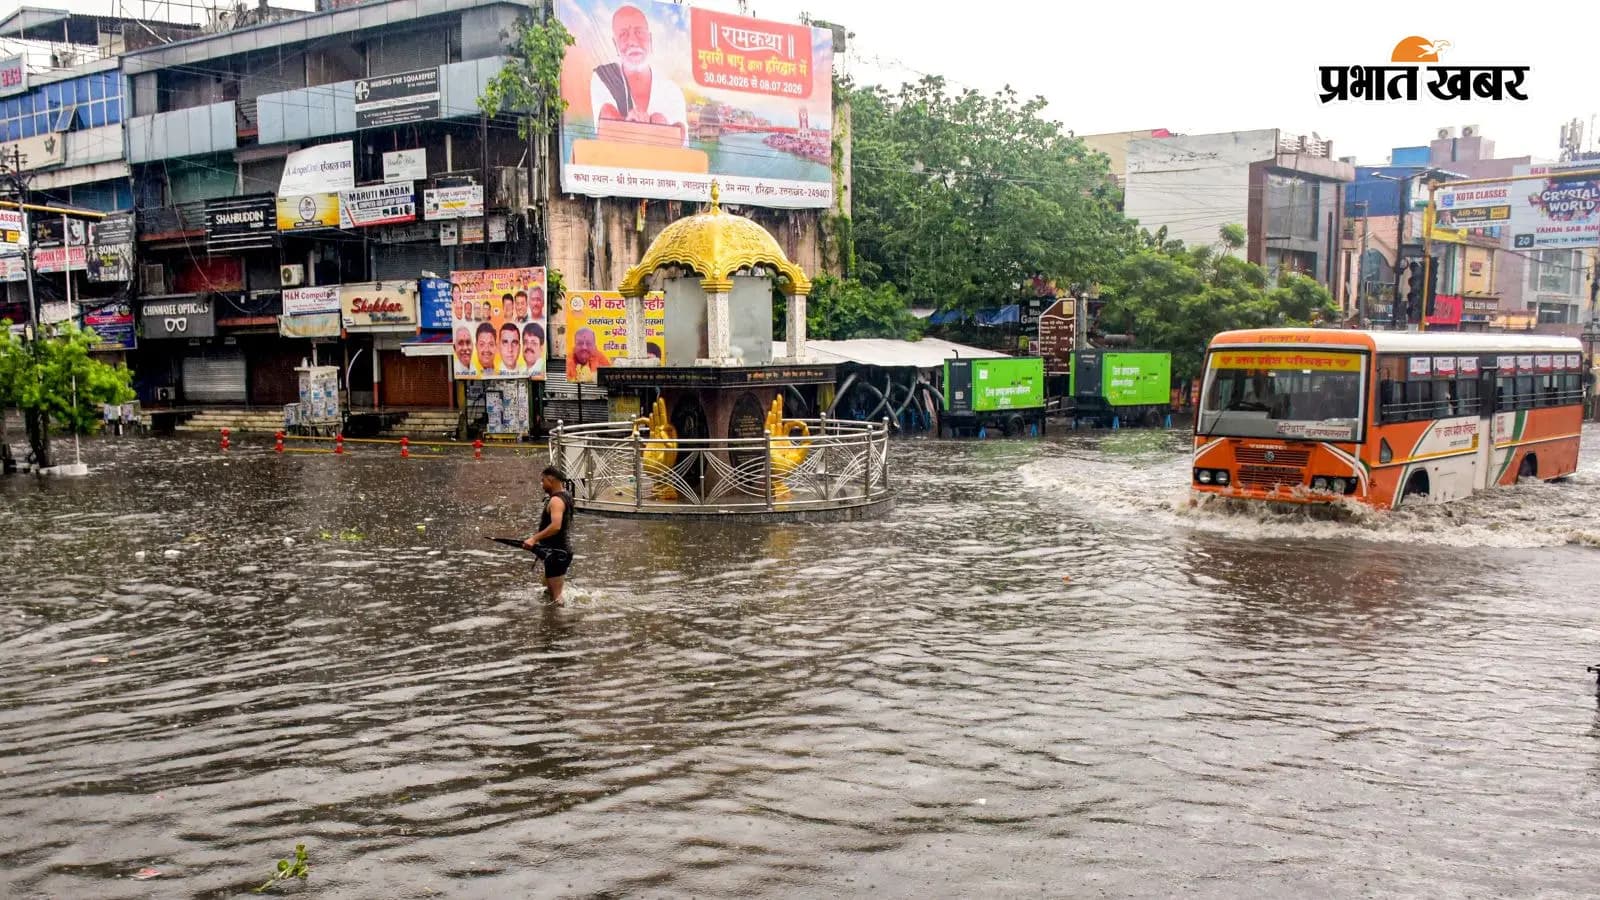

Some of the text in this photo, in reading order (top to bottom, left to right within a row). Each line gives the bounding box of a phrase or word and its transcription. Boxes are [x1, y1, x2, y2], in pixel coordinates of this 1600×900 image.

[721, 26, 783, 54] रामकथा
[703, 71, 749, 88] 30.06.2026
[759, 79, 803, 95] 08.07.2026
[348, 186, 411, 202] MARUTI NANDAN
[1456, 189, 1507, 201] KOTA CLASSES
[1541, 187, 1599, 202] CRYSTAL
[1549, 200, 1595, 213] WORLD
[0, 214, 22, 223] ASSES
[215, 210, 264, 225] SHAHBUDDIN
[55, 247, 86, 261] COMUTERS
[284, 290, 337, 300] H&H Computs
[588, 294, 602, 311] श्री
[143, 304, 176, 316] CHINMAYEE
